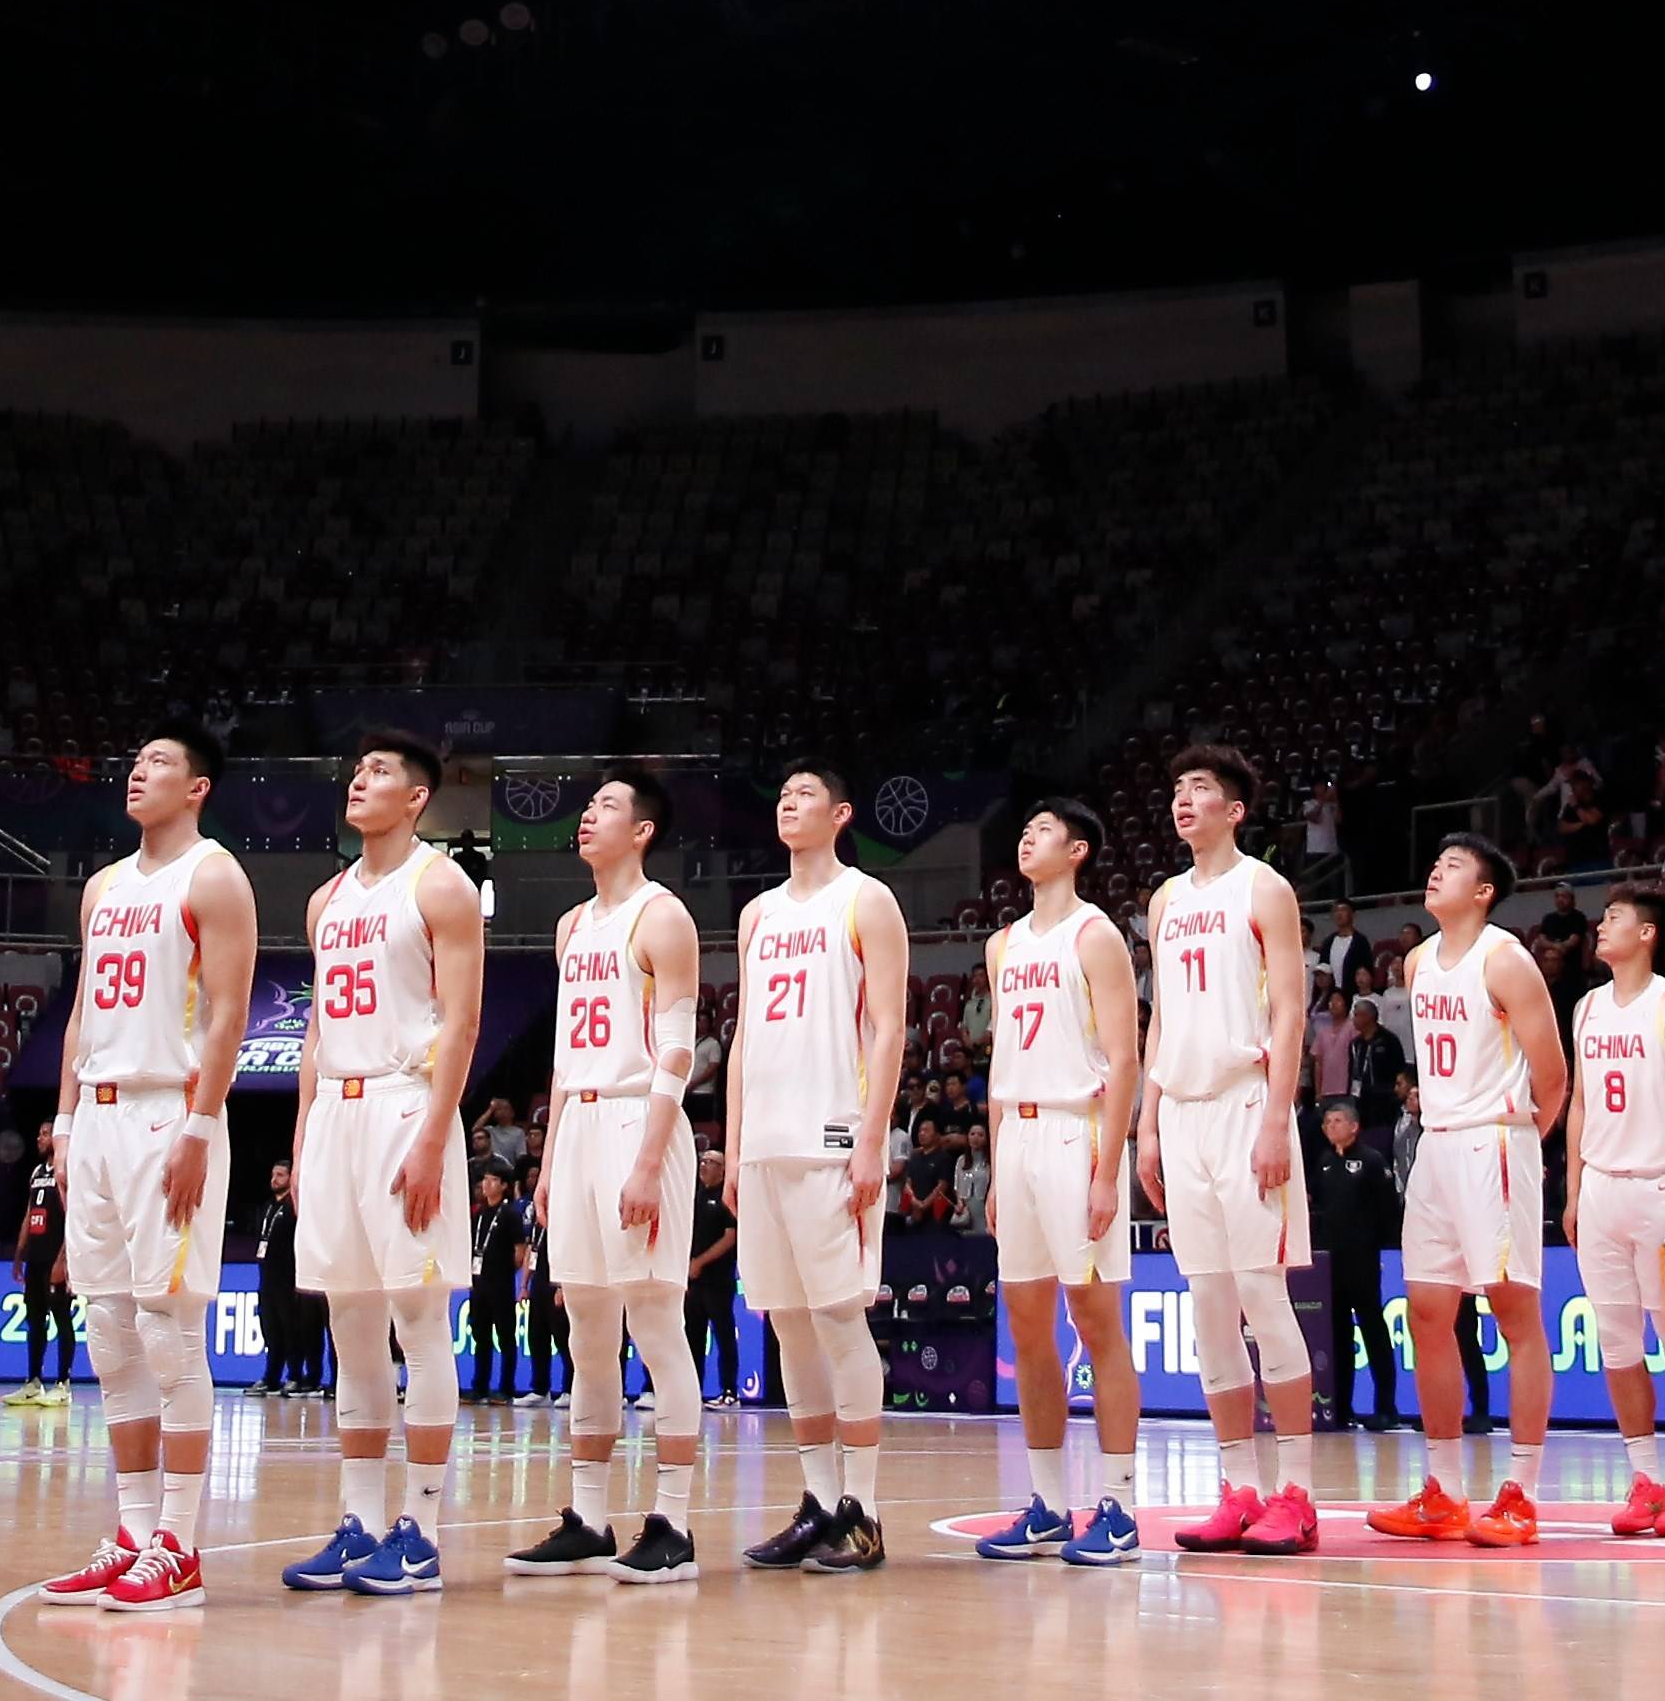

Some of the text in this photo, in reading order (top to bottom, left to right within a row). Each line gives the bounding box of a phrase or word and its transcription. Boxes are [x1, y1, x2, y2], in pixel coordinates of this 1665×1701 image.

[91, 903, 163, 938] CHINA
[1164, 909, 1227, 942] CHINA
[758, 925, 827, 962] CHINA
[94, 951, 147, 1010] 39
[564, 950, 621, 984] CHINA
[1002, 960, 1061, 994] CHINA
[1180, 947, 1207, 993] 11
[325, 960, 377, 1019] 35
[765, 969, 808, 1023] 21
[1415, 993, 1468, 1022] CHINA
[569, 996, 612, 1050] 26
[1011, 1002, 1045, 1051] 17
[249, 1041, 300, 1052] FIBA
[1425, 1033, 1458, 1078] 10
[1584, 1034, 1646, 1060] CHINA
[1604, 1070, 1627, 1114] 8
